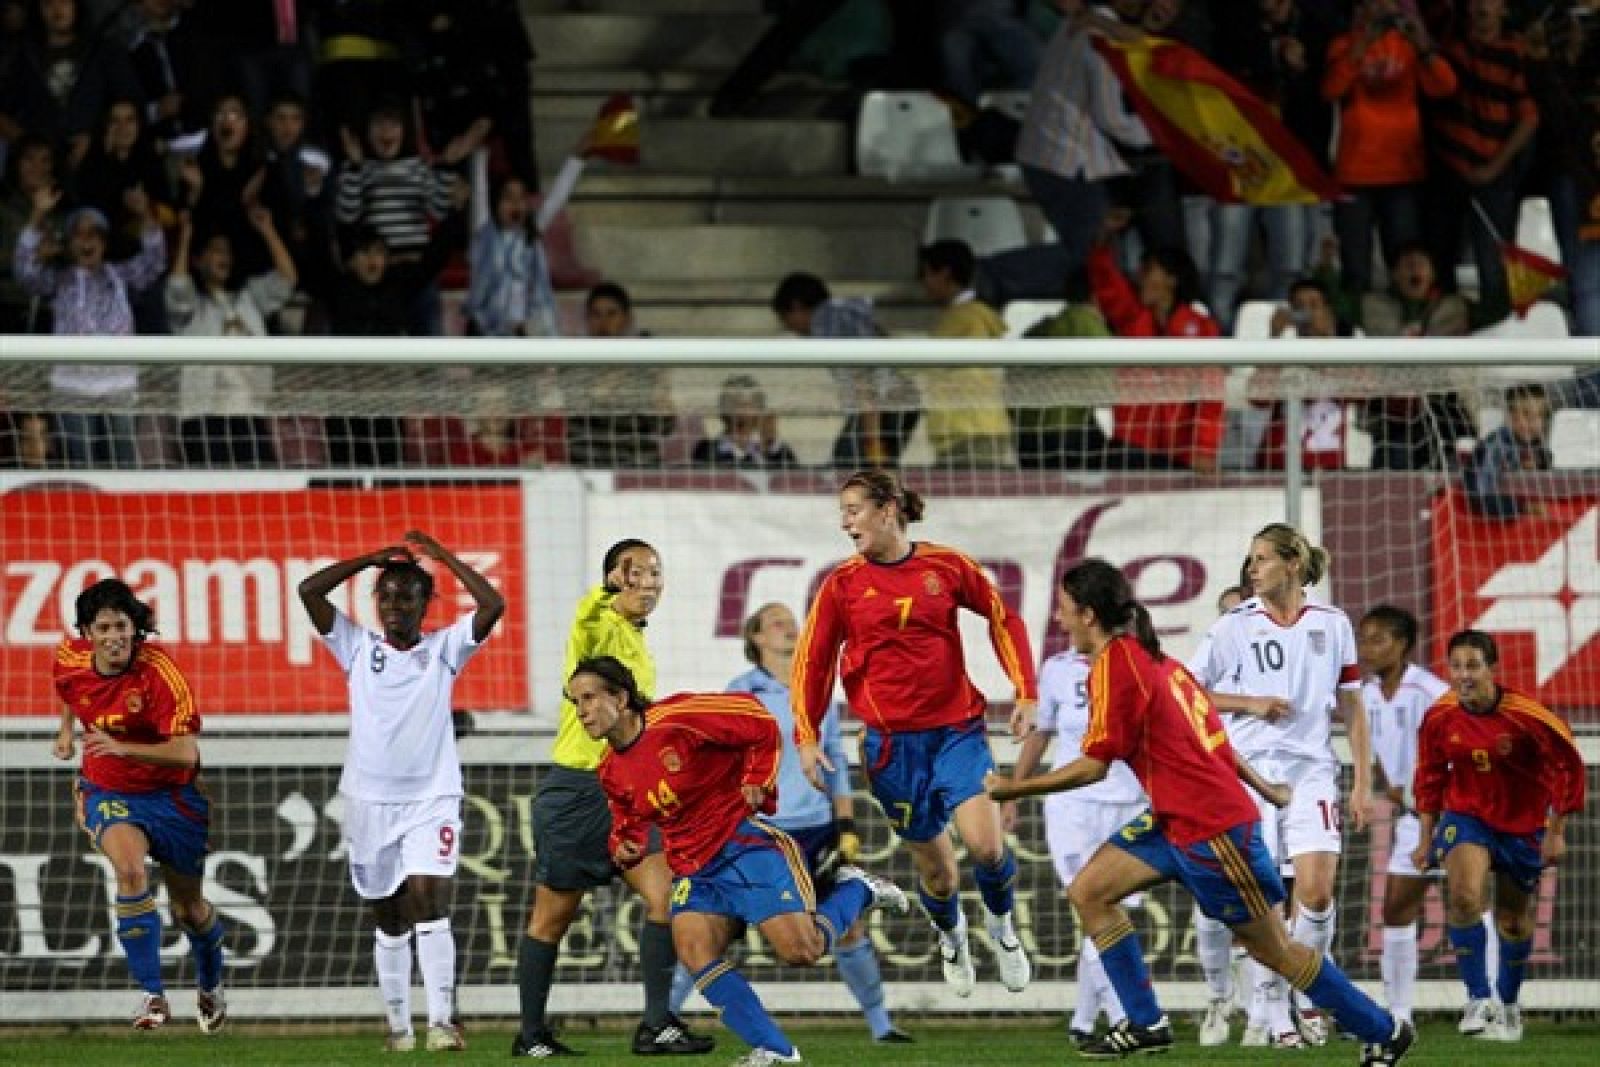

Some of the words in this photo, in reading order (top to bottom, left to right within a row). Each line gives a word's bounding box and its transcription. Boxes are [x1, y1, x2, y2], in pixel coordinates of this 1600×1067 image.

[713, 499, 1209, 668] rfe
[894, 597, 913, 631] 7
[1251, 640, 1284, 673] 10
[1074, 681, 1088, 710] 5
[1471, 748, 1491, 772] 9
[646, 778, 681, 817] 14
[438, 826, 455, 857] 9
